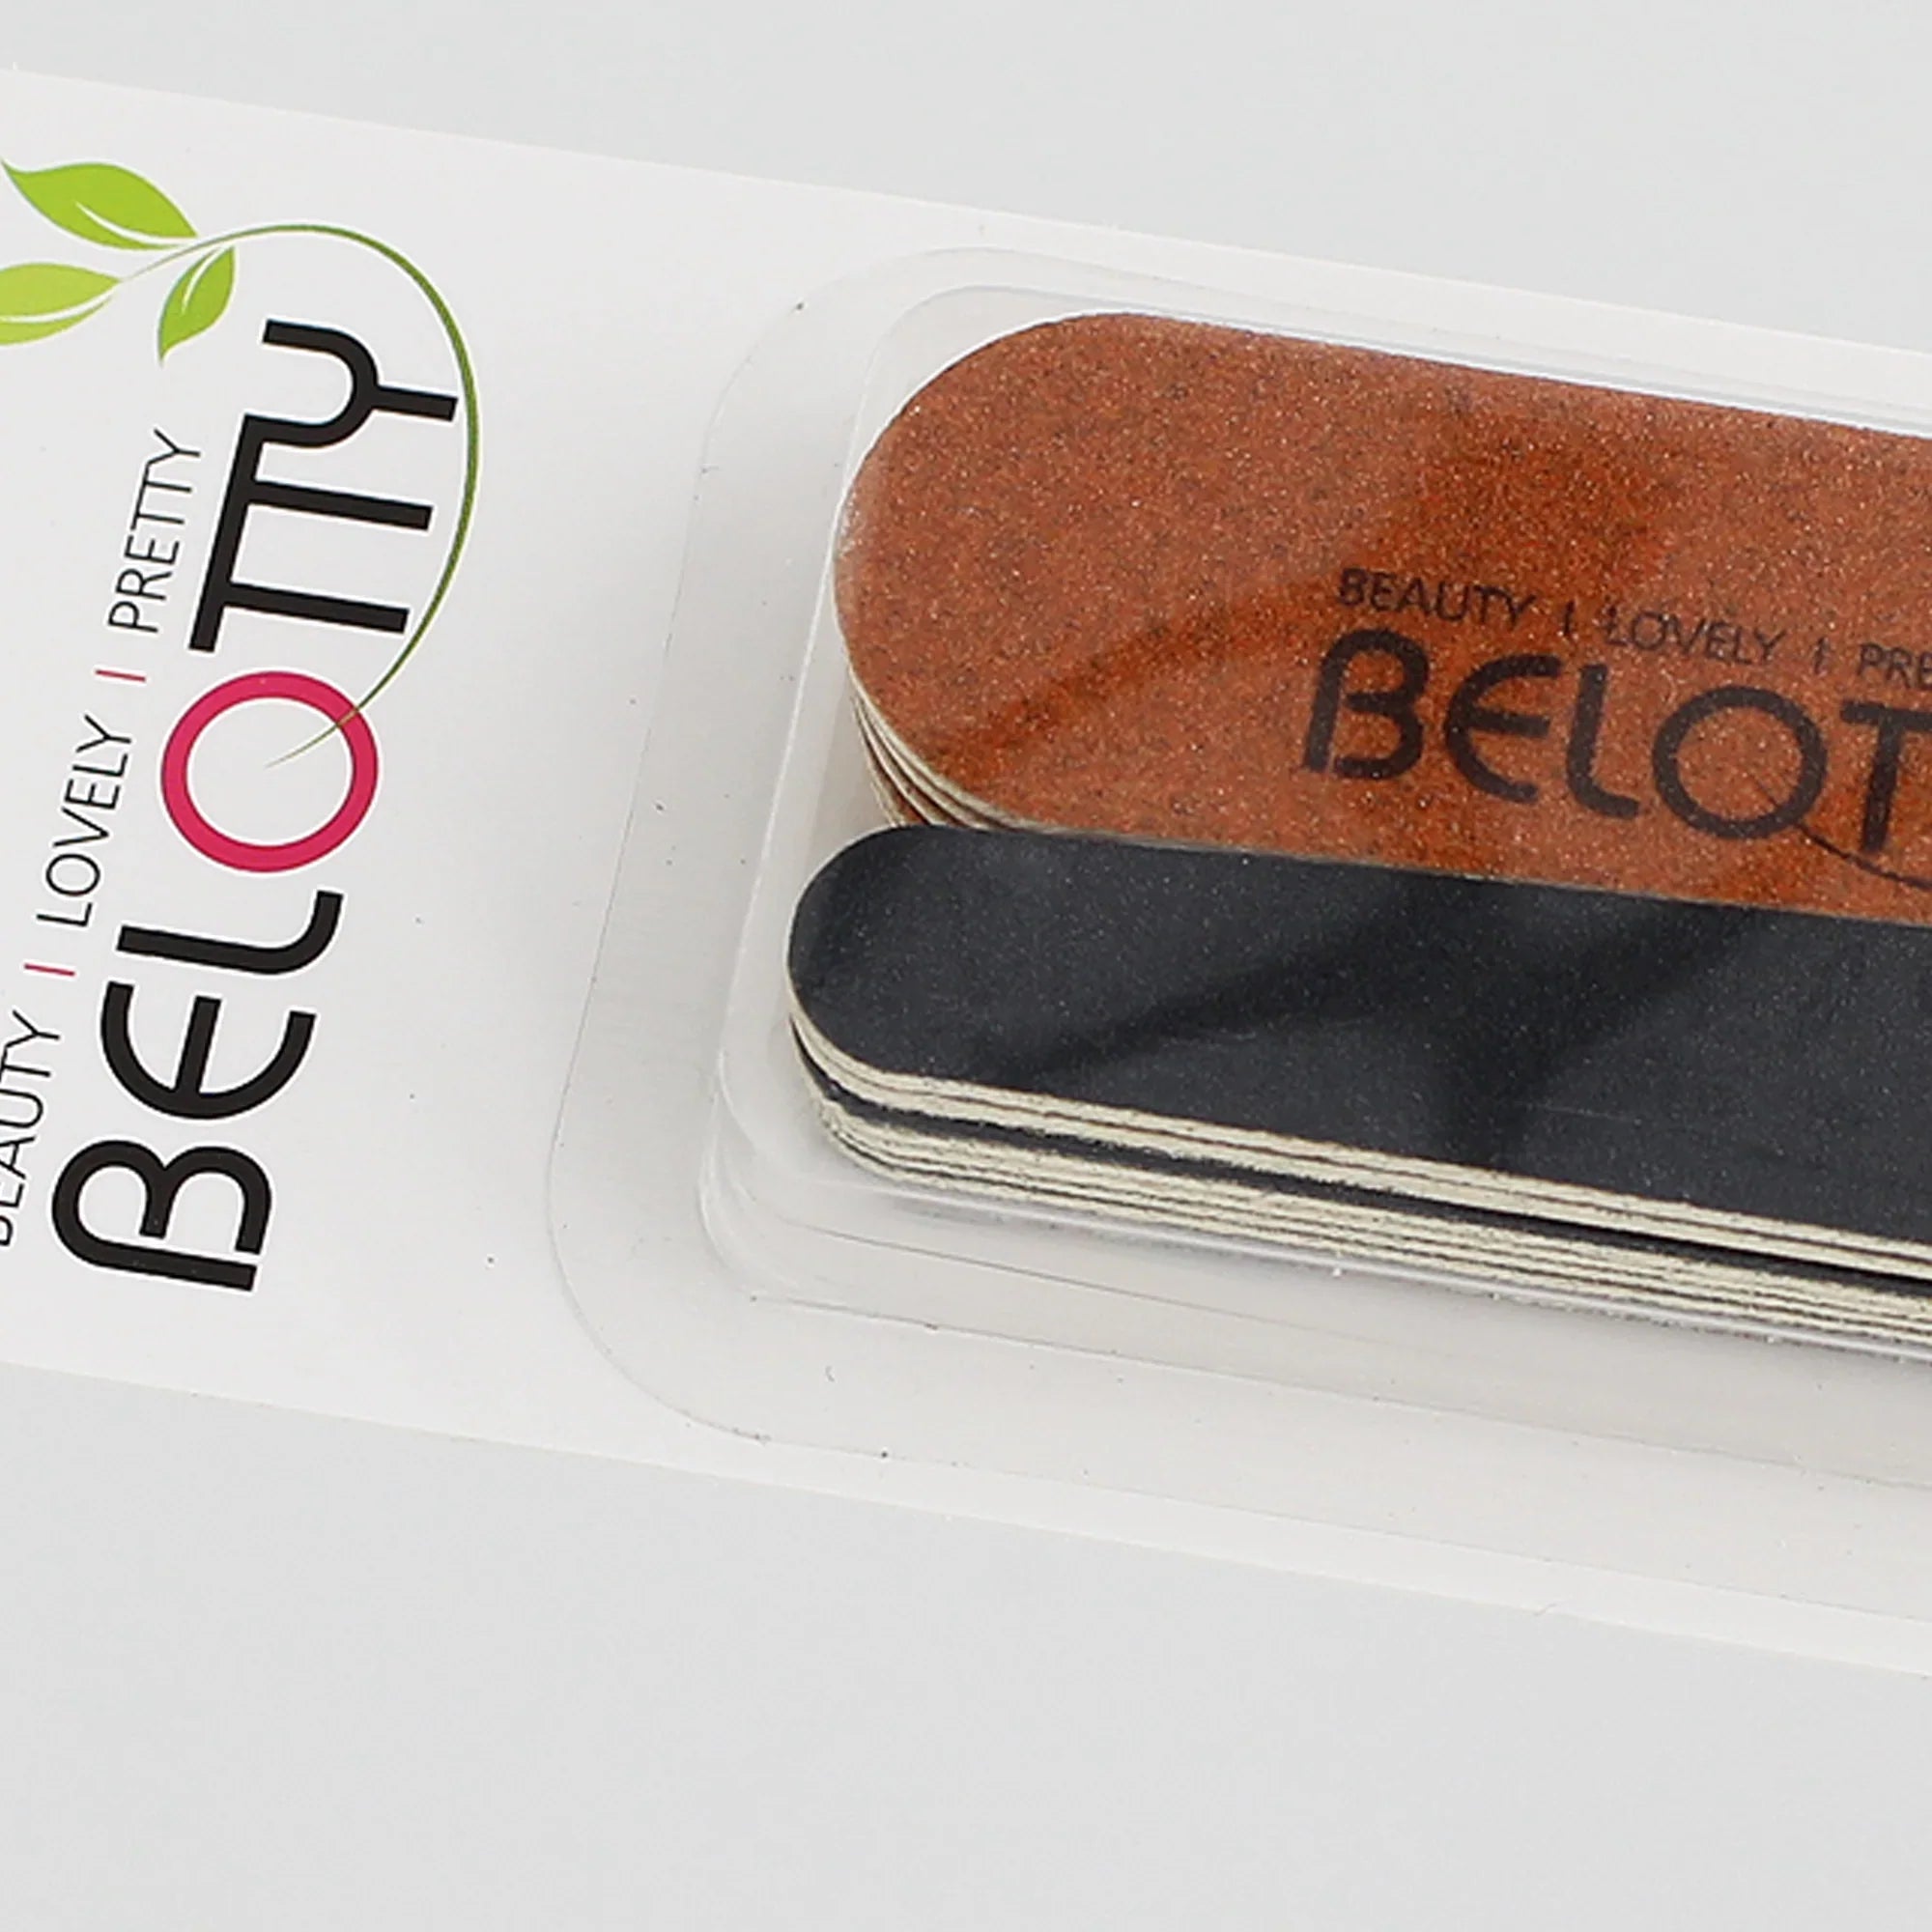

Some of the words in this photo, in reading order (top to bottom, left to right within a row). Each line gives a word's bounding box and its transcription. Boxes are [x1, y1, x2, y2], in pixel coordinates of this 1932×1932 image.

[0, 1009, 61, 1246] AUTY
[36, 714, 131, 928] LOVELY
[107, 429, 201, 633] PRETTY
[52, 319, 459, 1292] BELOTTY
[1336, 567, 1536, 630] BEAUTY
[1602, 609, 1785, 665] LOVELY
